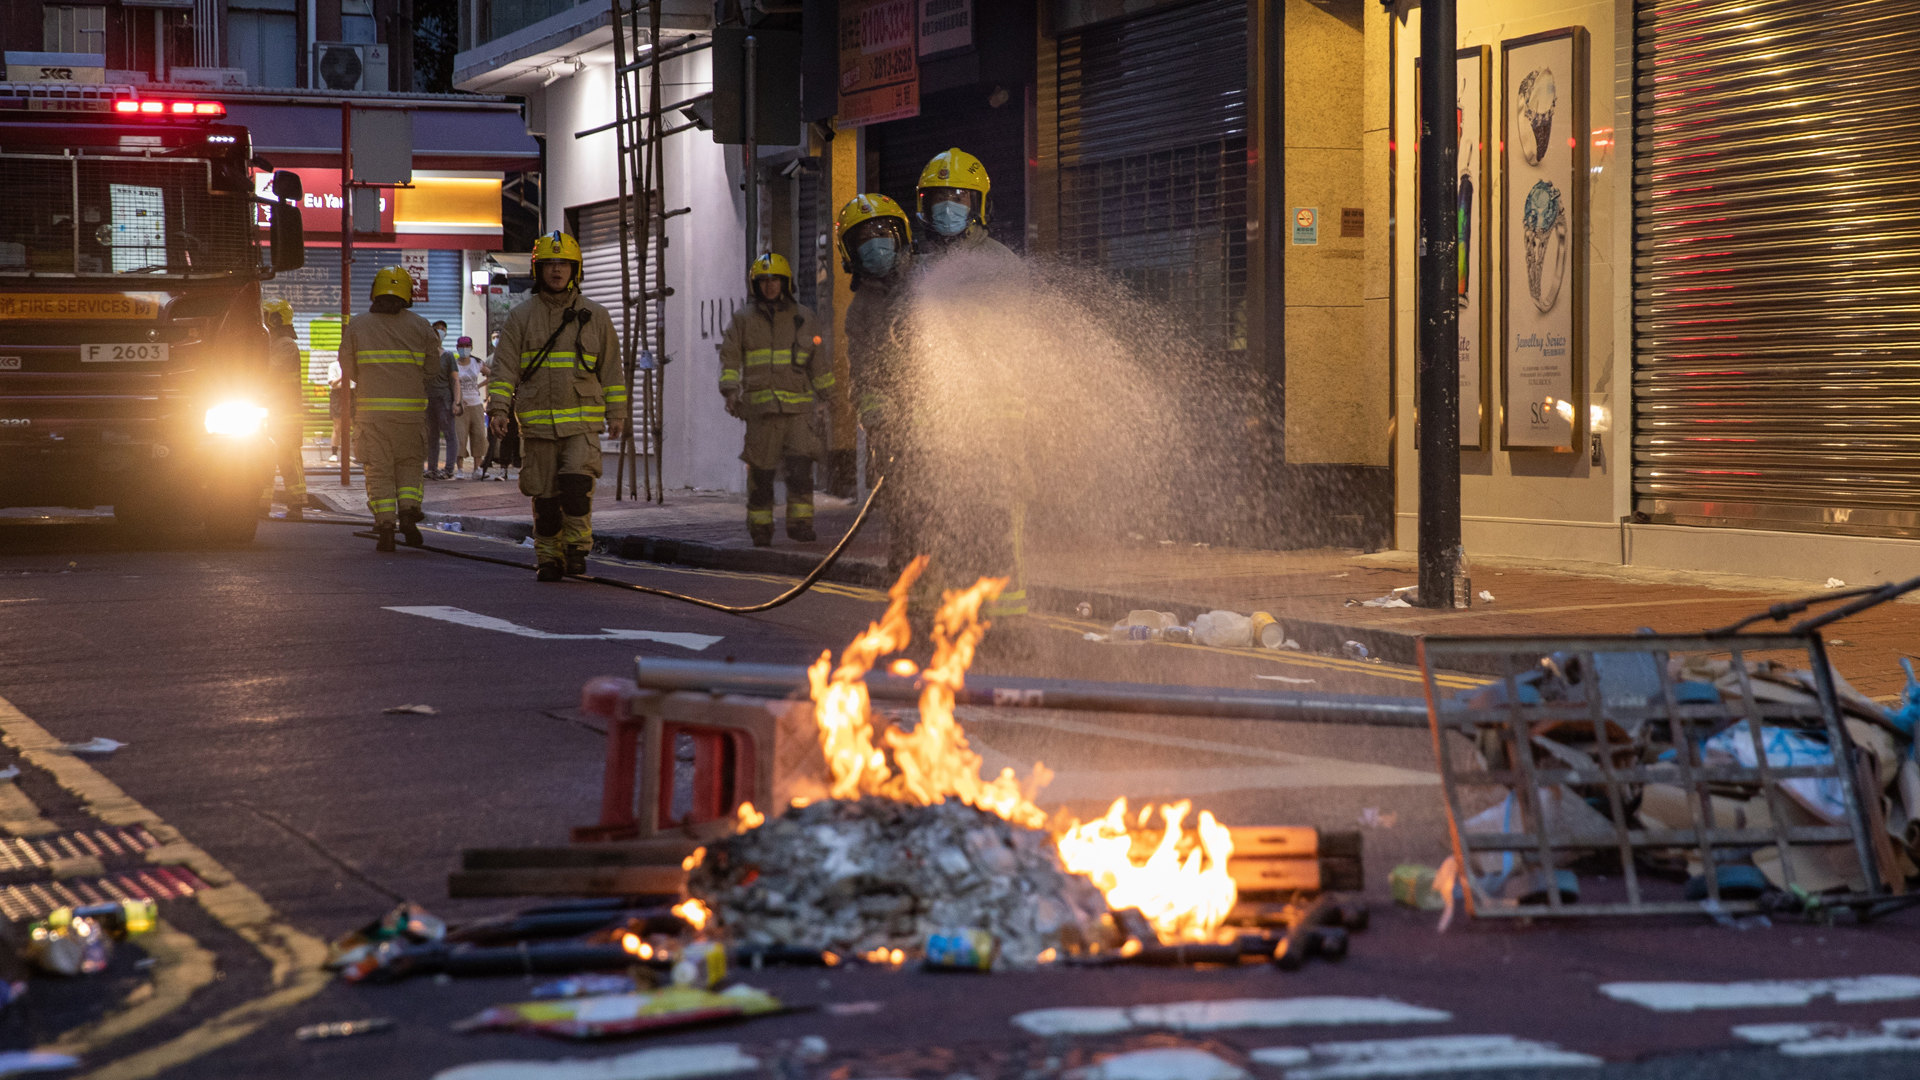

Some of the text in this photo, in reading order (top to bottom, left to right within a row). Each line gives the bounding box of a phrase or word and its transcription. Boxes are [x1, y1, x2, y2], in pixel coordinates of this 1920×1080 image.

[43, 100, 97, 110] FIRE
[304, 193, 323, 208] Eu
[20, 299, 53, 313] FIRE
[58, 299, 130, 313] SERVICES
[1545, 332, 1566, 348] Series
[89, 345, 160, 360] F 2603
